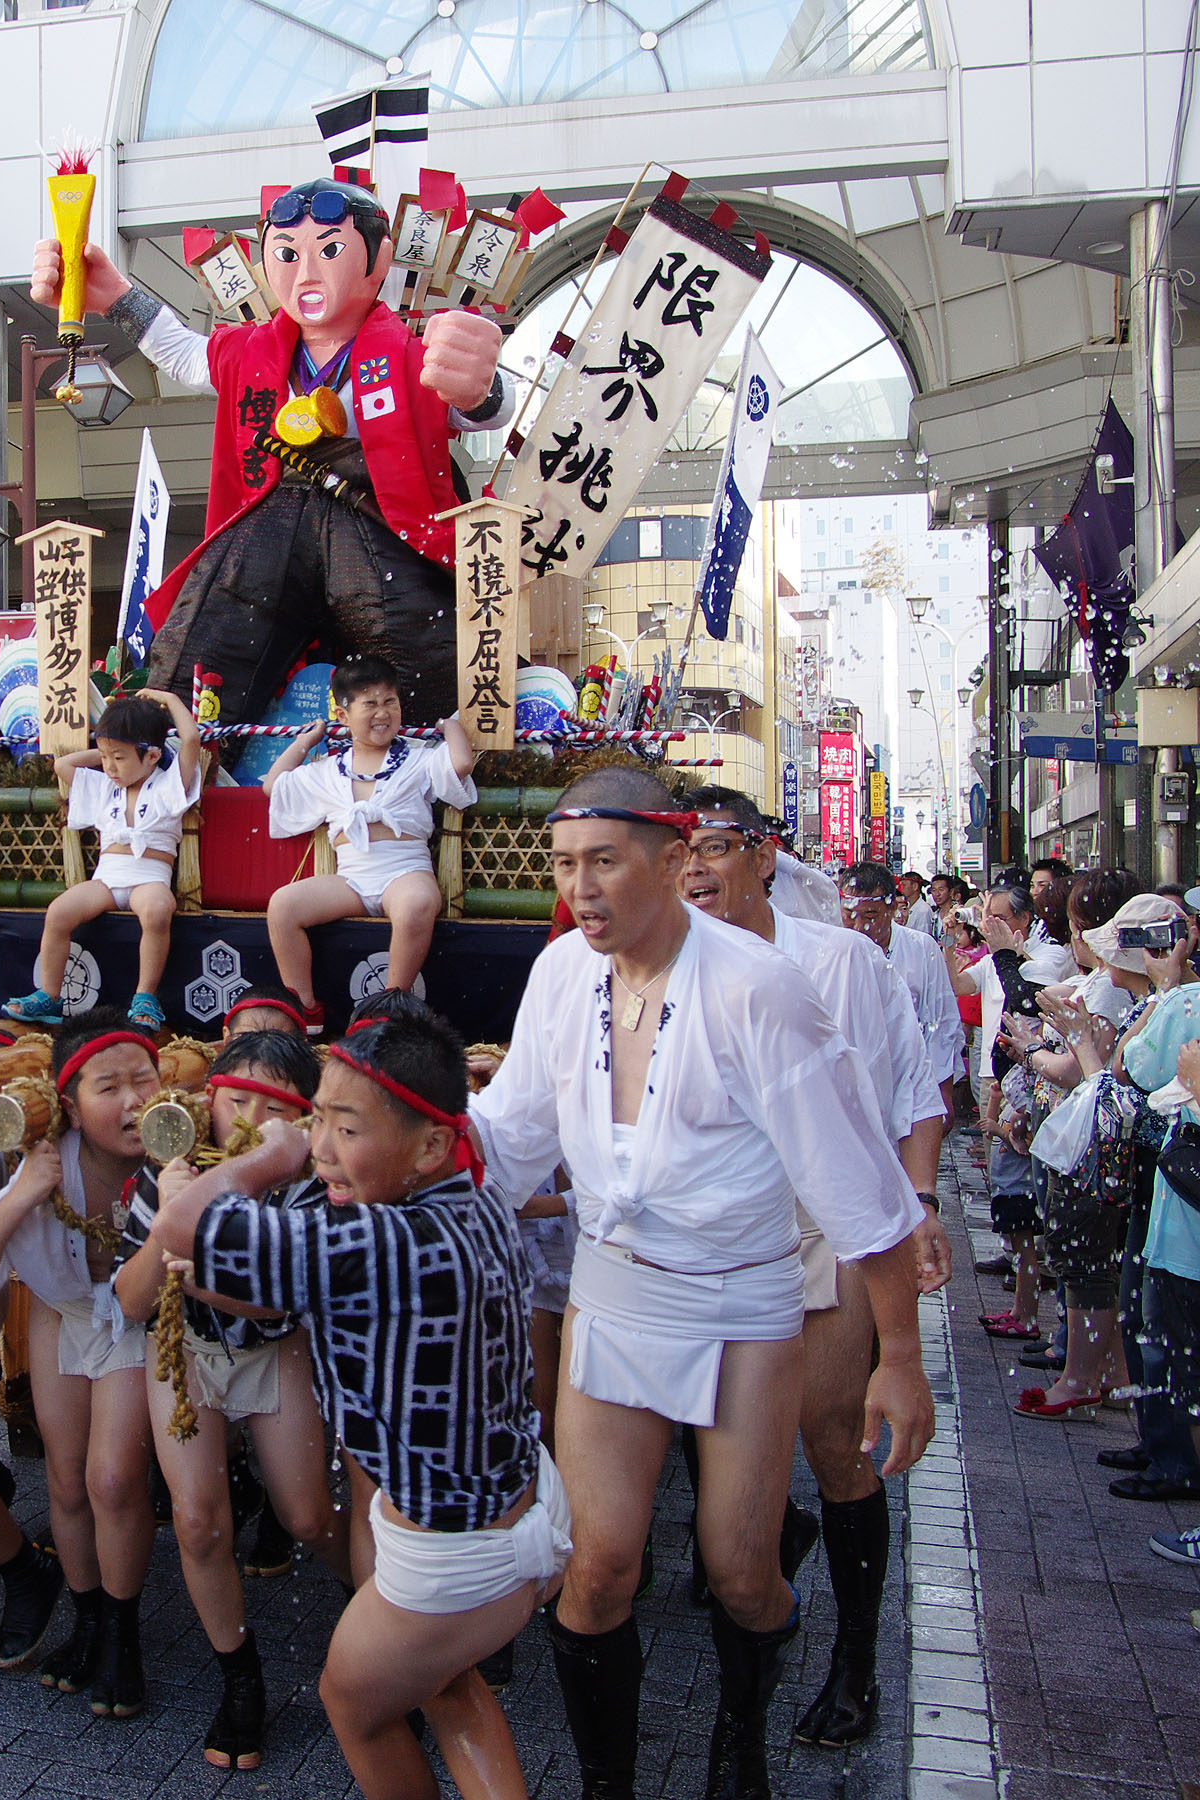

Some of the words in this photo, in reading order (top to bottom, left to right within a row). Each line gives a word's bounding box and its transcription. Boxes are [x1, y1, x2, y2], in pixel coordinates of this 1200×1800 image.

[400, 211, 436, 262] 奈良屋
[465, 227, 504, 280] 冷泉
[209, 256, 247, 299] 大浜
[34, 540, 61, 604] 山笠
[60, 536, 87, 598] 子供
[43, 598, 86, 730] 博多流
[823, 746, 852, 763] 焼肉
